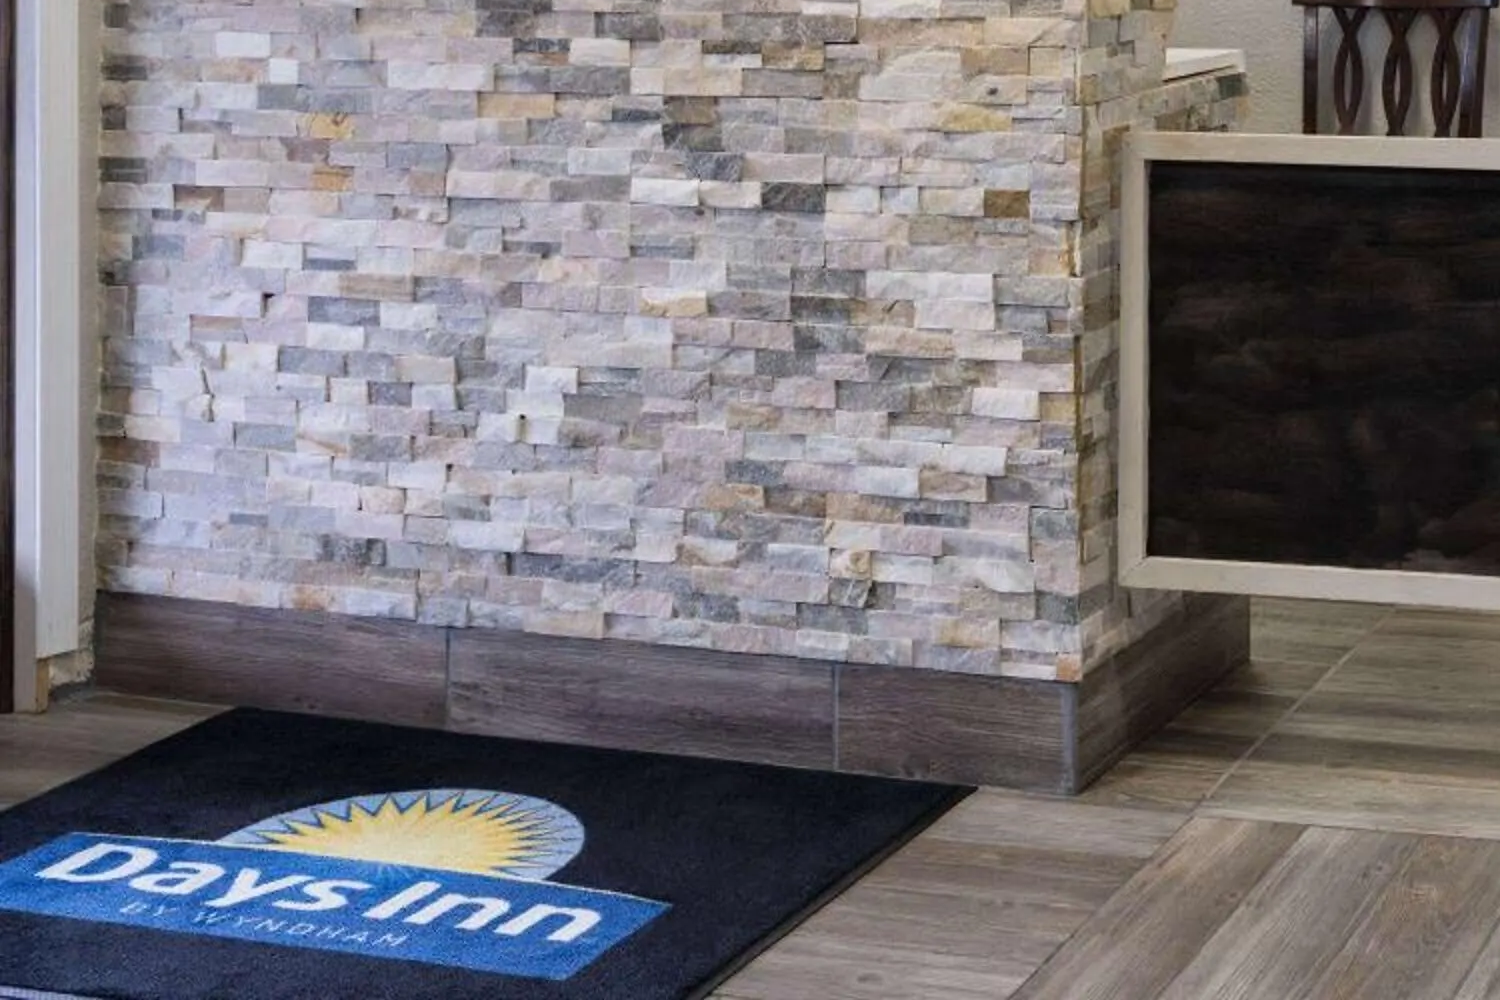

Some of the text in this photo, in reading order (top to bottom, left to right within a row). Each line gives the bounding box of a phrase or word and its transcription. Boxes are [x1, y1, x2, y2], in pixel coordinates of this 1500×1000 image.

[36, 843, 601, 942] Days Inn
[118, 901, 410, 947] BY WYNDHAM
